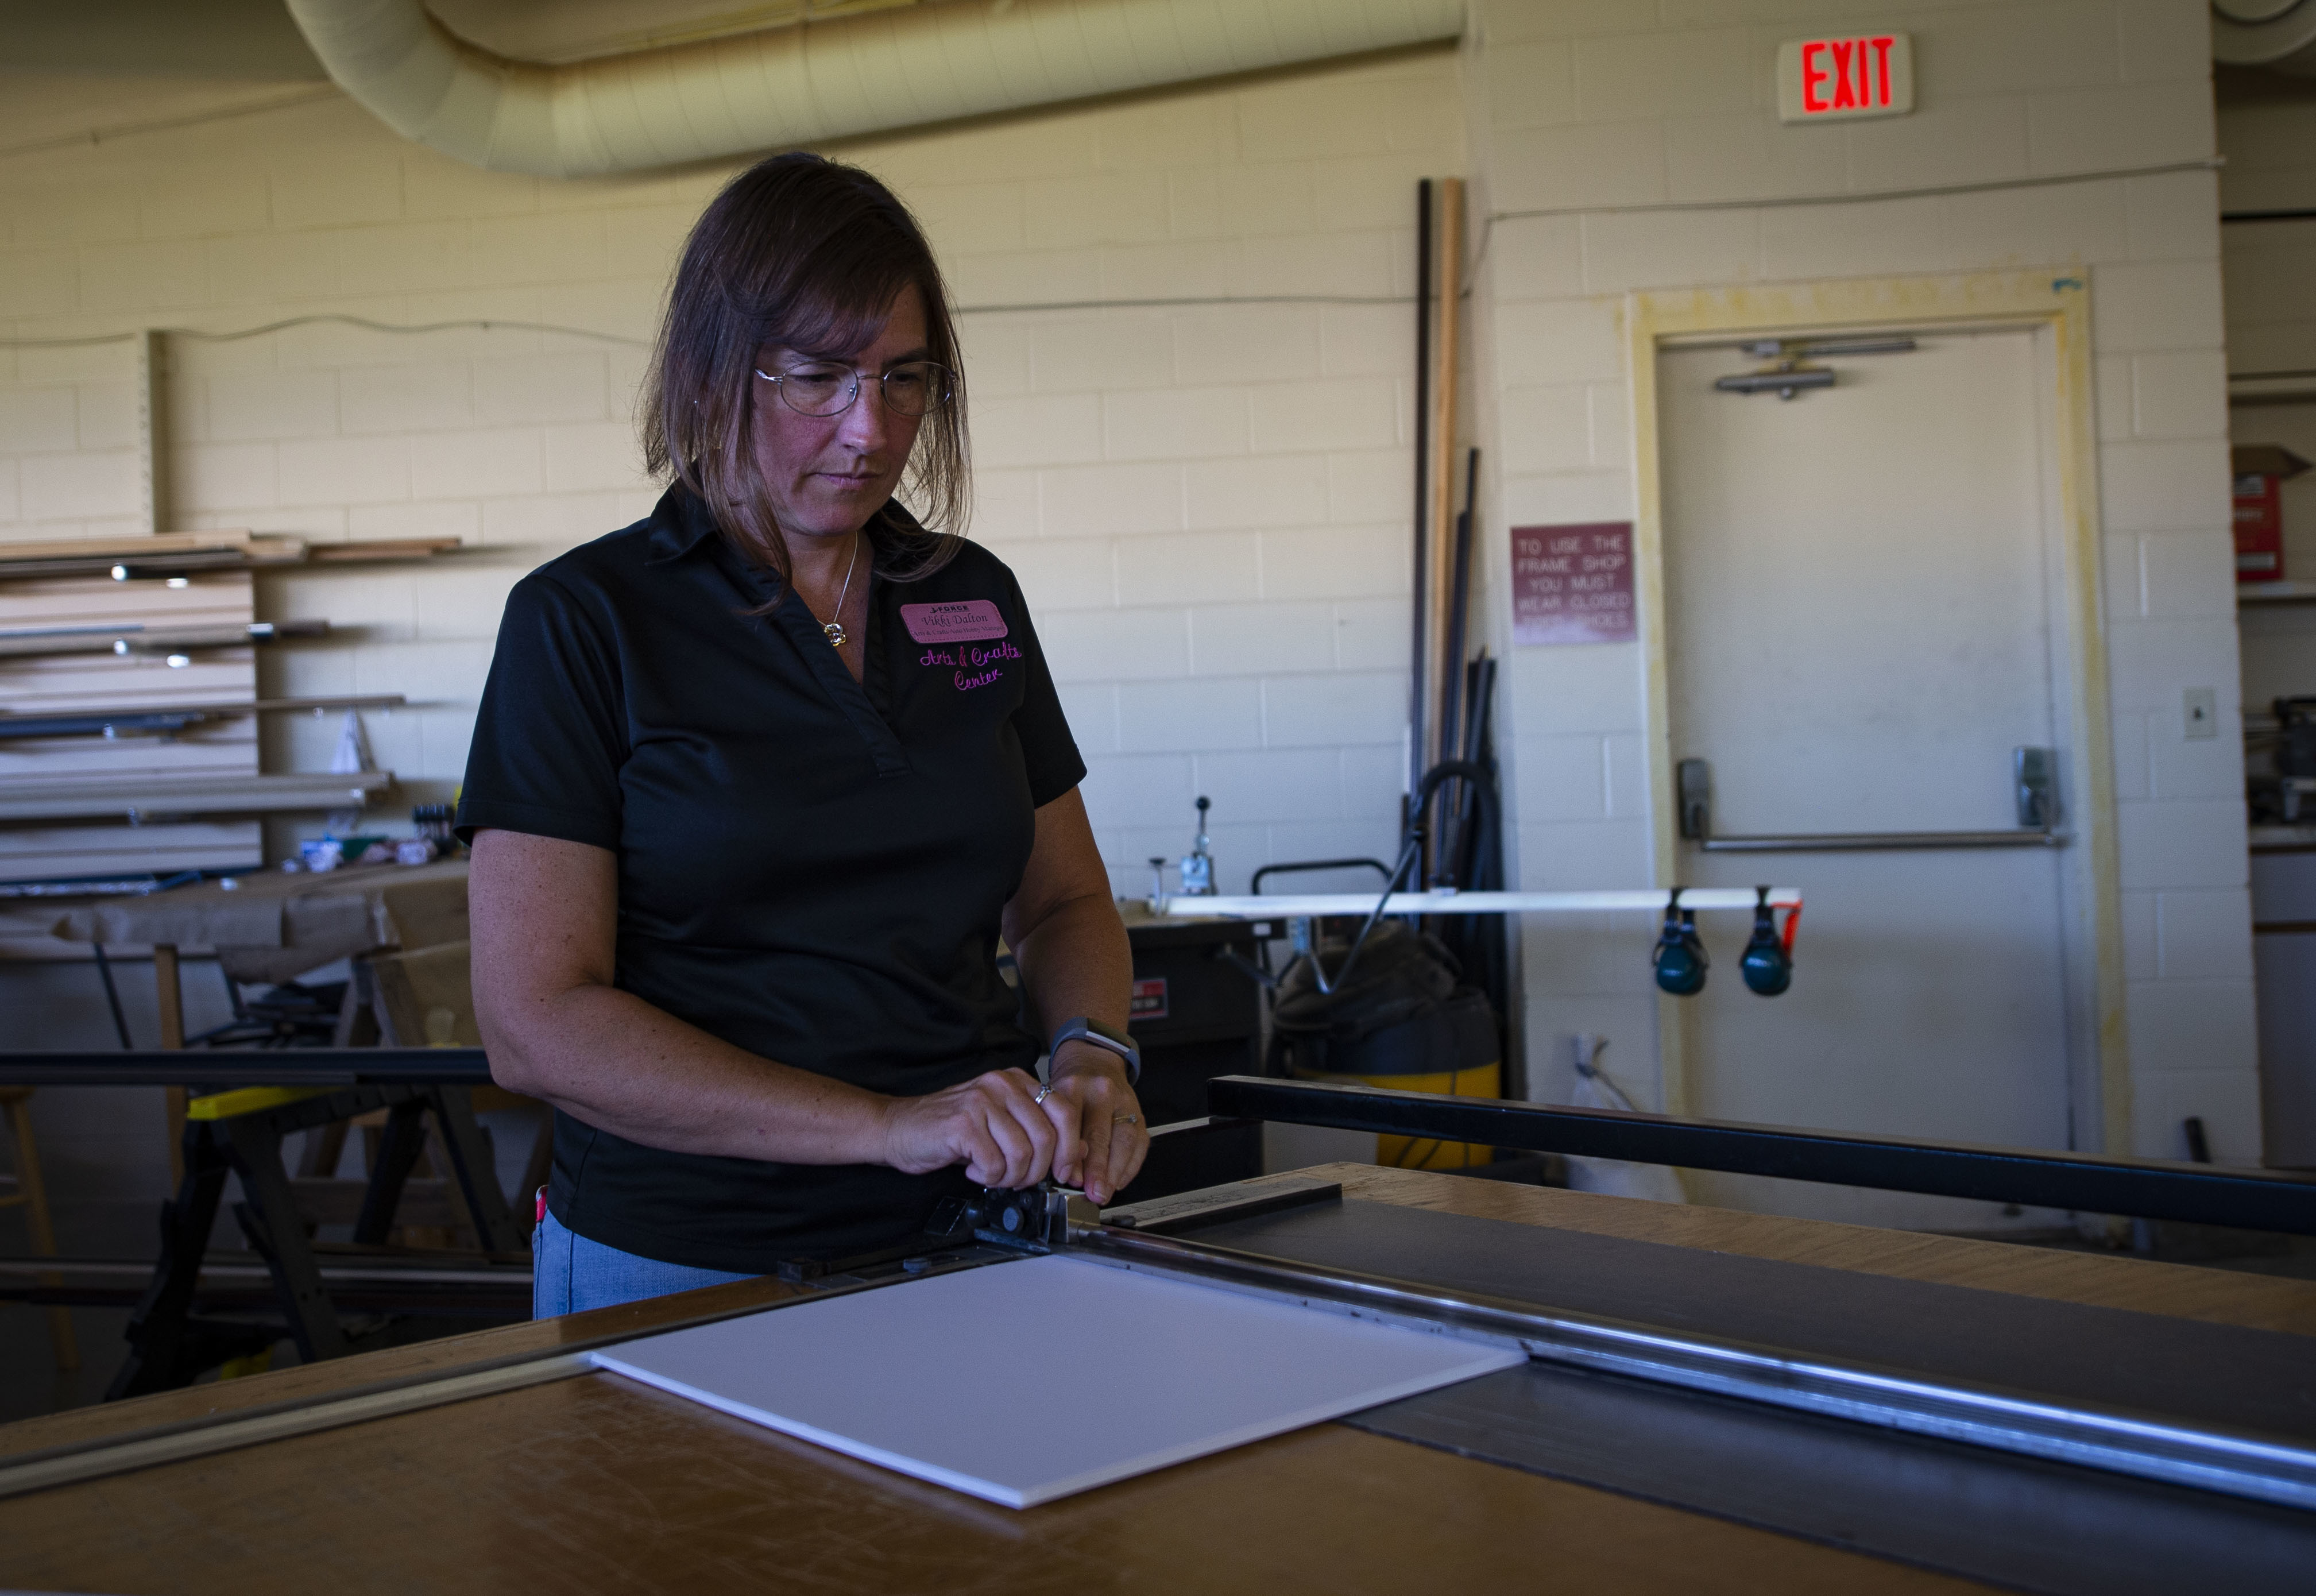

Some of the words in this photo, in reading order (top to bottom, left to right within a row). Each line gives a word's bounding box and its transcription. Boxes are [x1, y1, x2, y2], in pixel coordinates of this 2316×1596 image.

[1801, 36, 1896, 114] EXIT
[1518, 538, 1542, 556] TO
[1549, 536, 1582, 555] USE
[1593, 534, 1625, 552] THE
[1517, 555, 1571, 574] FRAME
[1582, 552, 1627, 571] SHOP
[1529, 576, 1563, 593] YOU
[1571, 573, 1616, 591] MUST
[921, 615, 951, 627] Vikki
[952, 613, 988, 624] Dalton
[920, 649, 956, 666] Arts
[959, 646, 968, 667] &
[971, 642, 1022, 666] Crafts
[954, 668, 1003, 690] Center
